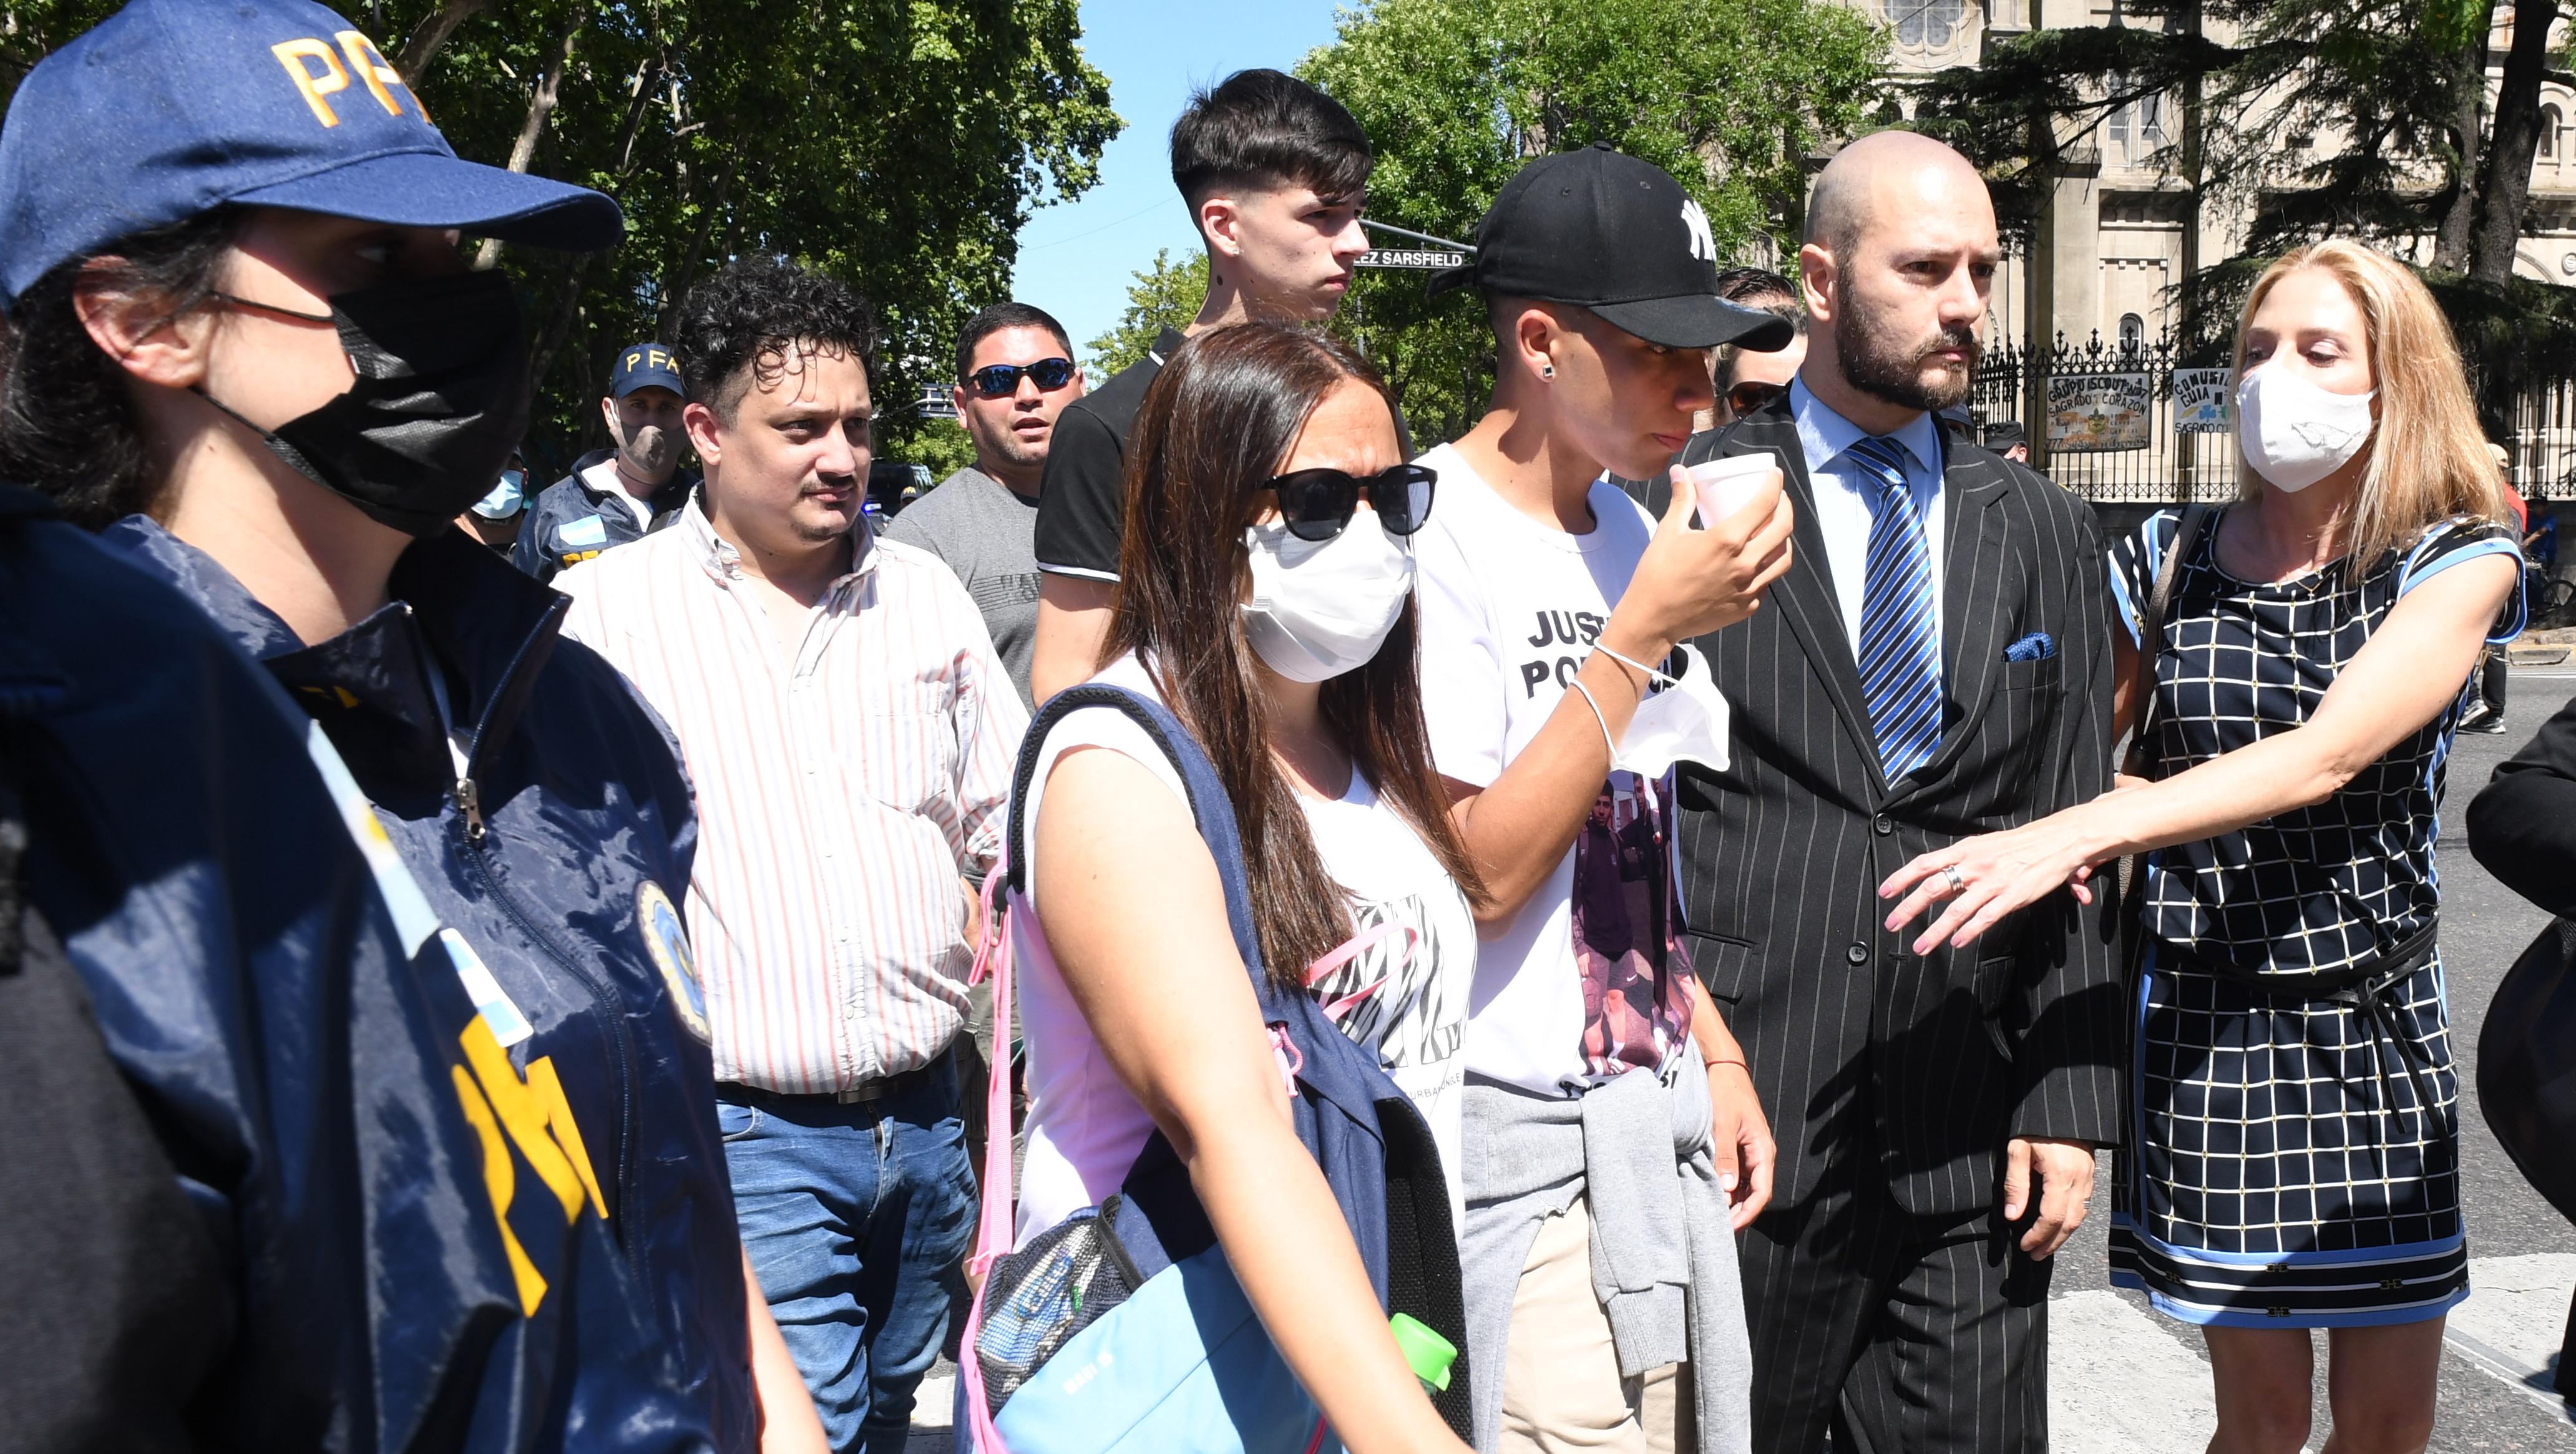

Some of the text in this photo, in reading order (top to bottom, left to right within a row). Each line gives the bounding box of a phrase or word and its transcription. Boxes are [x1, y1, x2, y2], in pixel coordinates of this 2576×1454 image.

[271, 30, 432, 127] PF
[1382, 251, 1462, 266] SARSFIELD
[2048, 393, 2147, 417] SAGRADO CORAZON
[2180, 387, 2210, 407] GUIA
[2175, 422, 2215, 432] SAGRADO
[1528, 610, 1609, 647] JUST
[1521, 656, 1587, 699] PO
